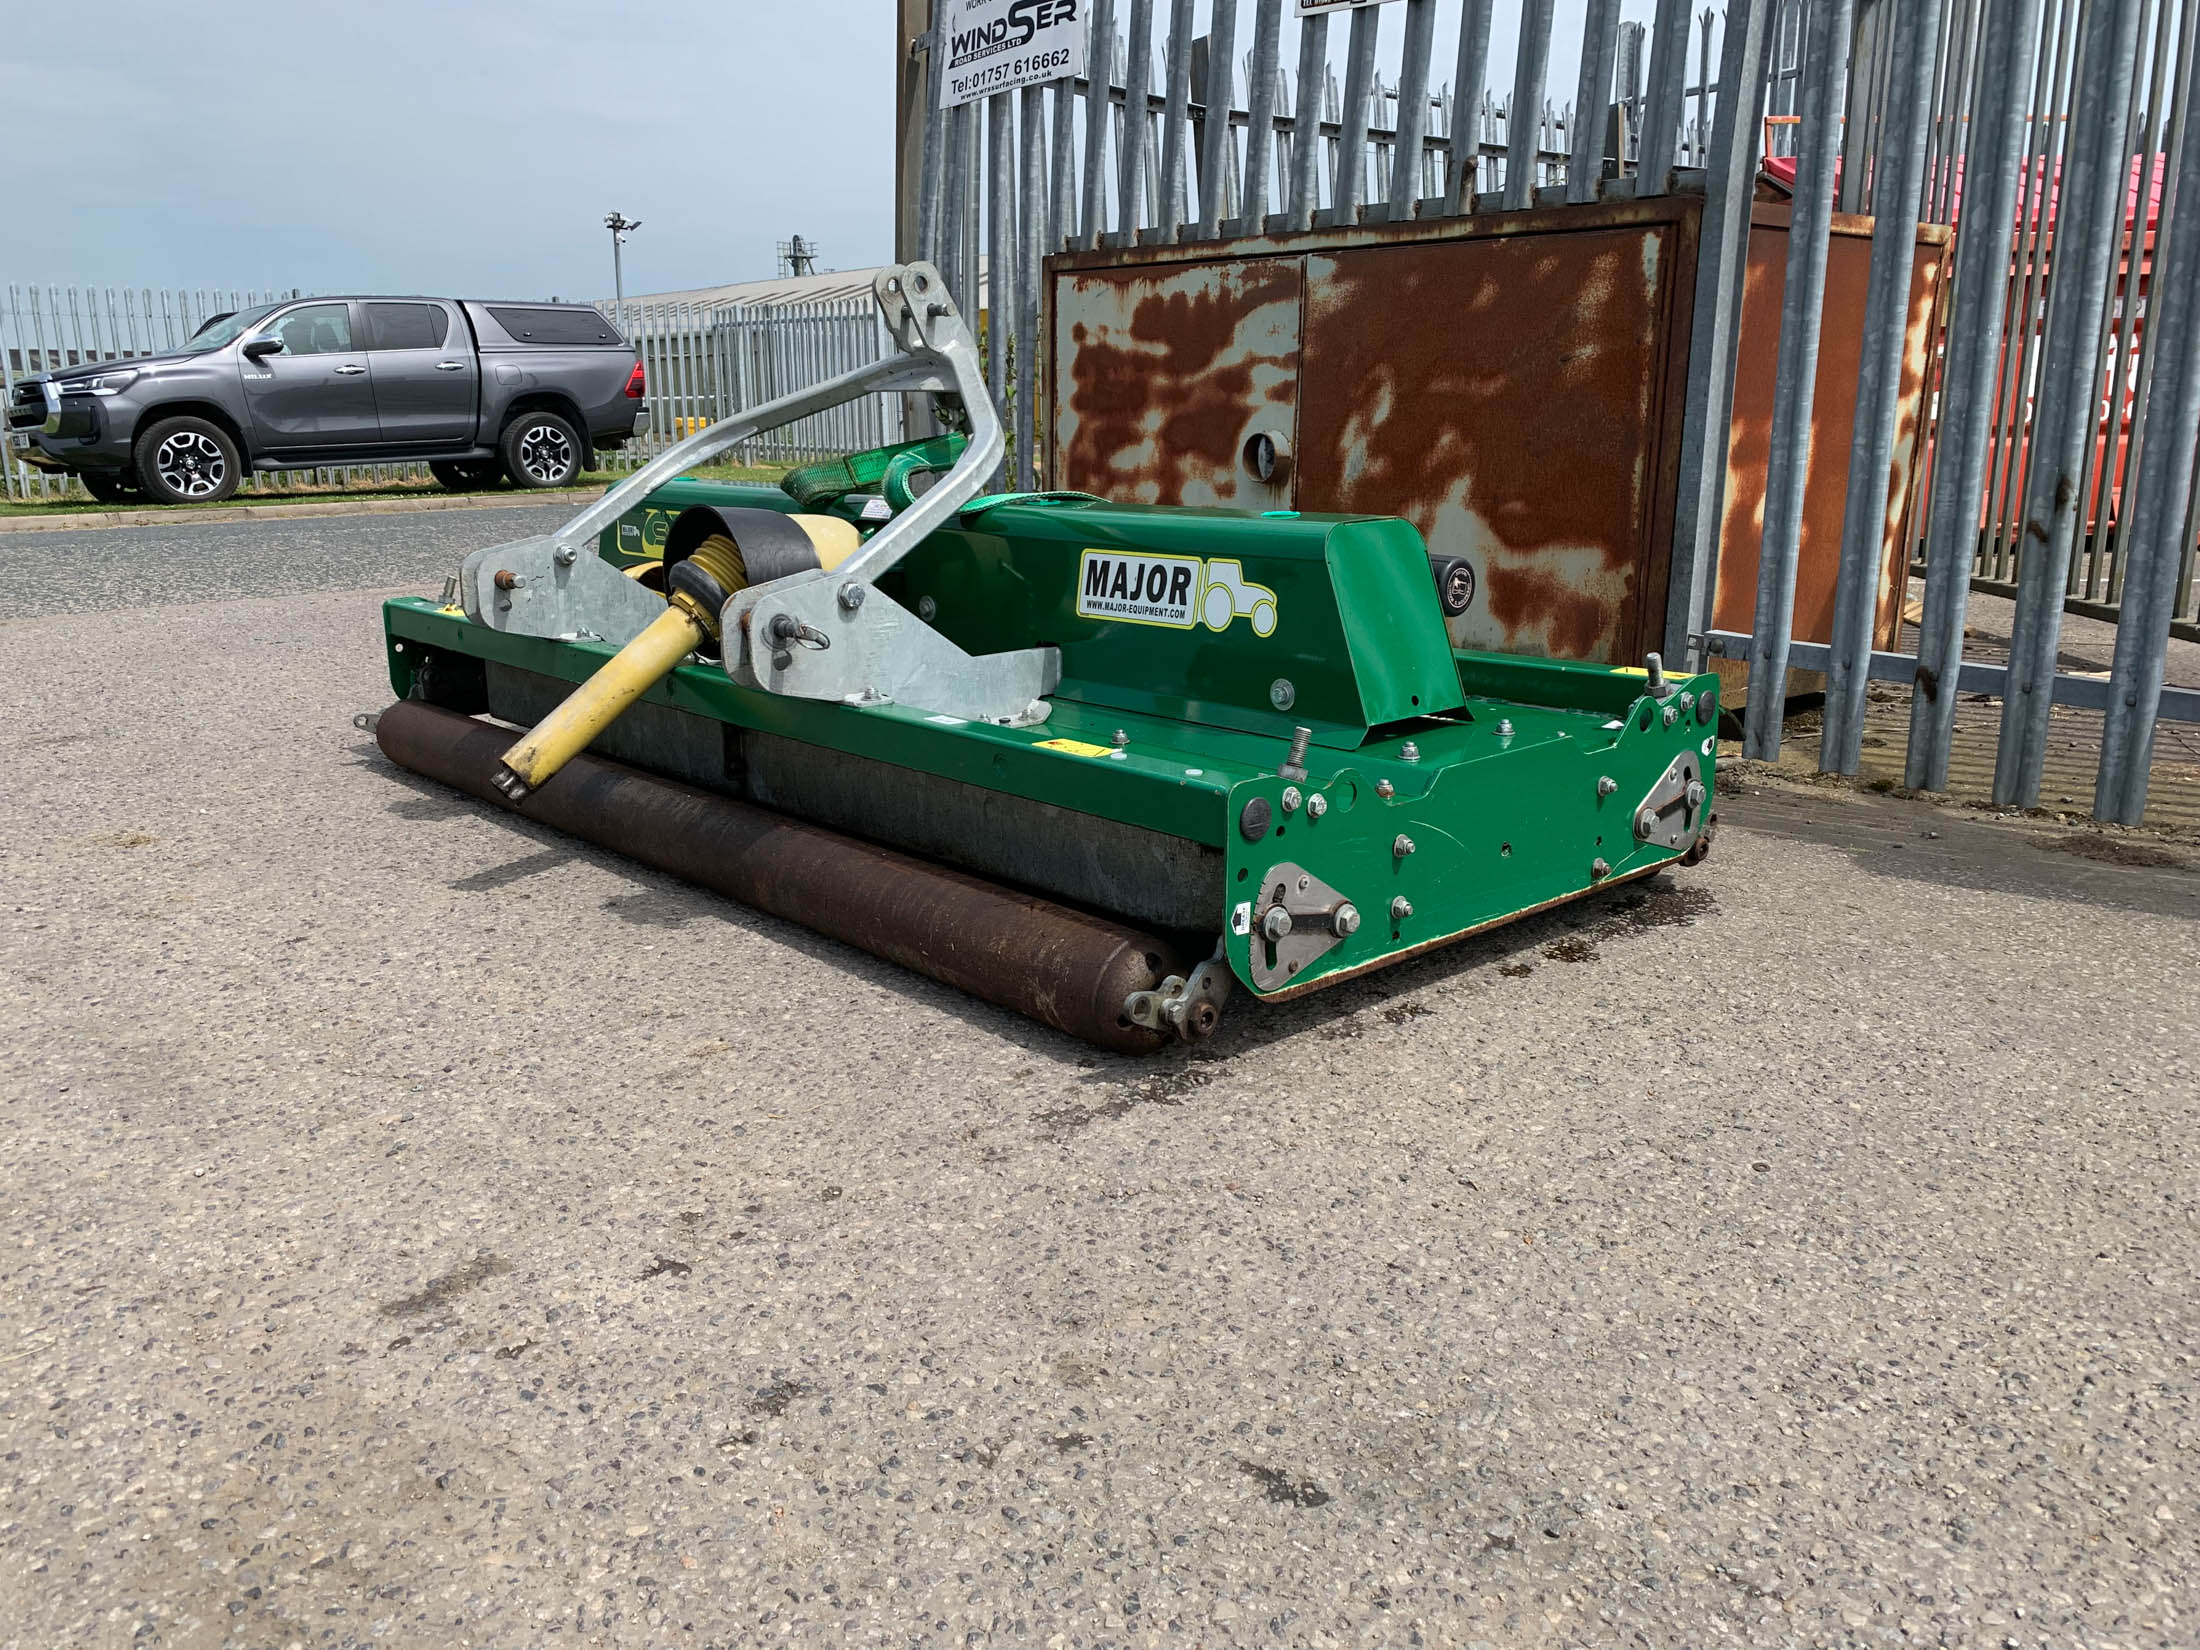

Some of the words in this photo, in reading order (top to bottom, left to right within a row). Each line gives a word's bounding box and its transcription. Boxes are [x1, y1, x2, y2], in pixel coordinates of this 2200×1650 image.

[951, 0, 1077, 57] WINDSER
[951, 63, 1010, 94] Tel:01757
[1014, 48, 1070, 75] 616662
[954, 54, 972, 67] ROAD
[973, 44, 1006, 60] SERVICES
[1007, 38, 1022, 49] LTD
[960, 69, 1052, 100] www.wrssurfacing.co.uk
[1085, 559, 1192, 606] MAJOR
[1087, 600, 1186, 619] WWW.MAJOR-EQUIPMENT.COM
